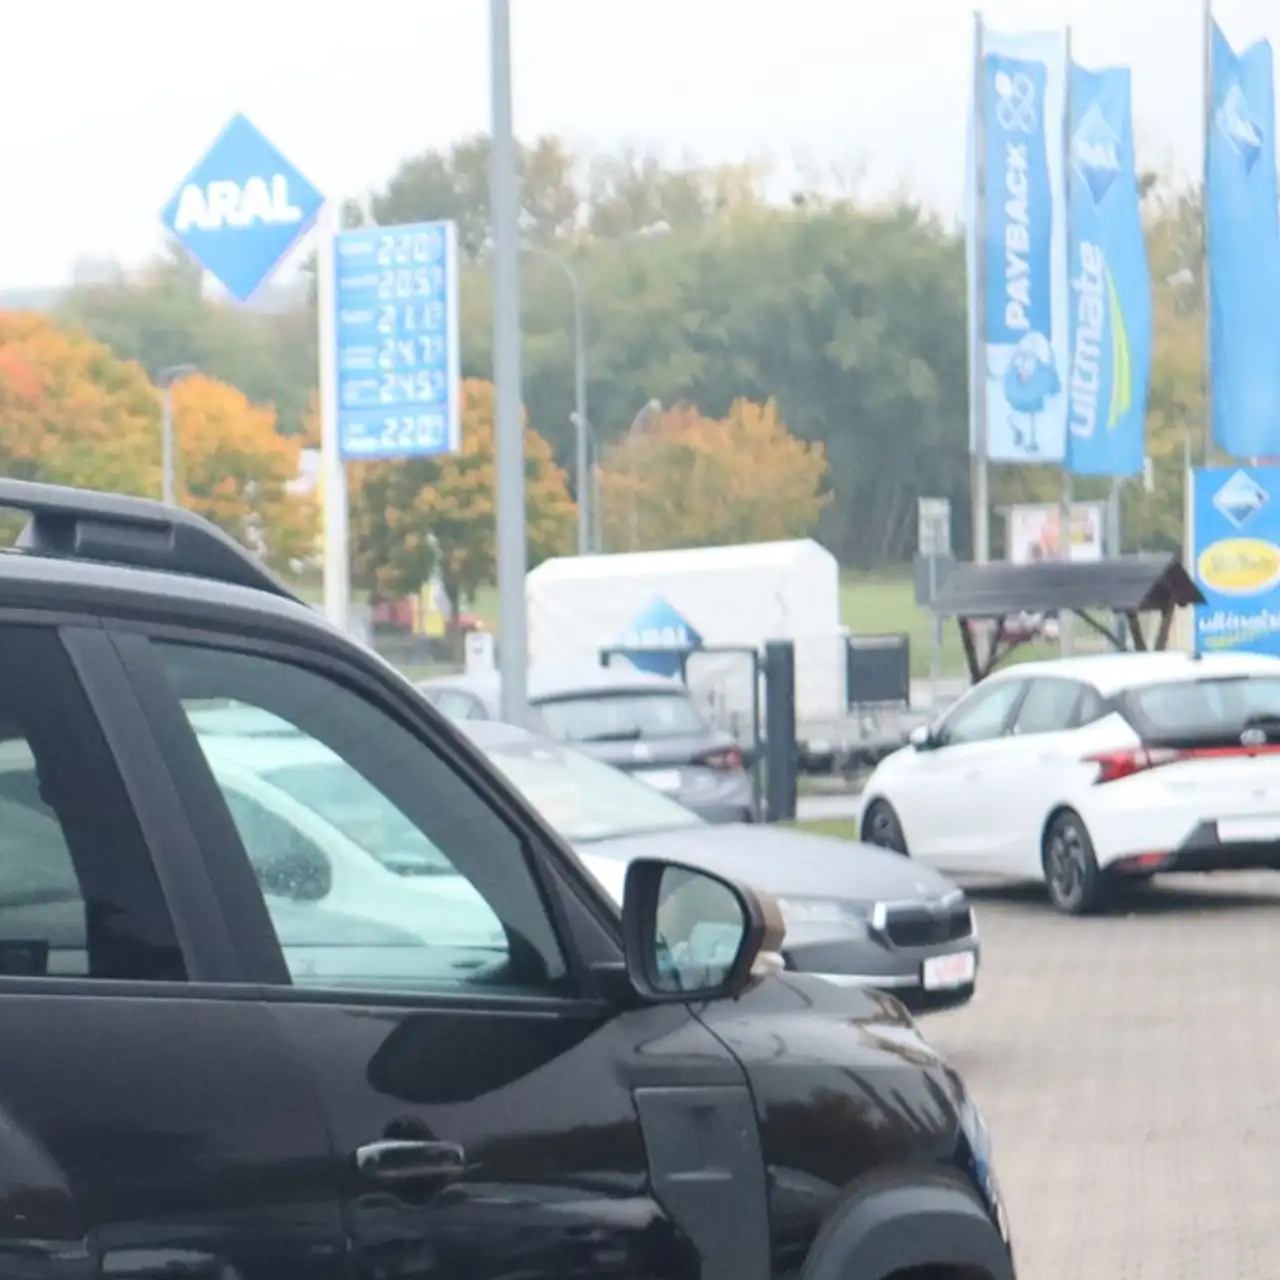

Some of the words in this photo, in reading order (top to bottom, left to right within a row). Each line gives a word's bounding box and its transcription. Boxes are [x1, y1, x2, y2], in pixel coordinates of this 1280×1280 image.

[174, 173, 303, 234] ARAL
[1005, 141, 1032, 330] PAYBACK
[1070, 239, 1107, 439] ultimate
